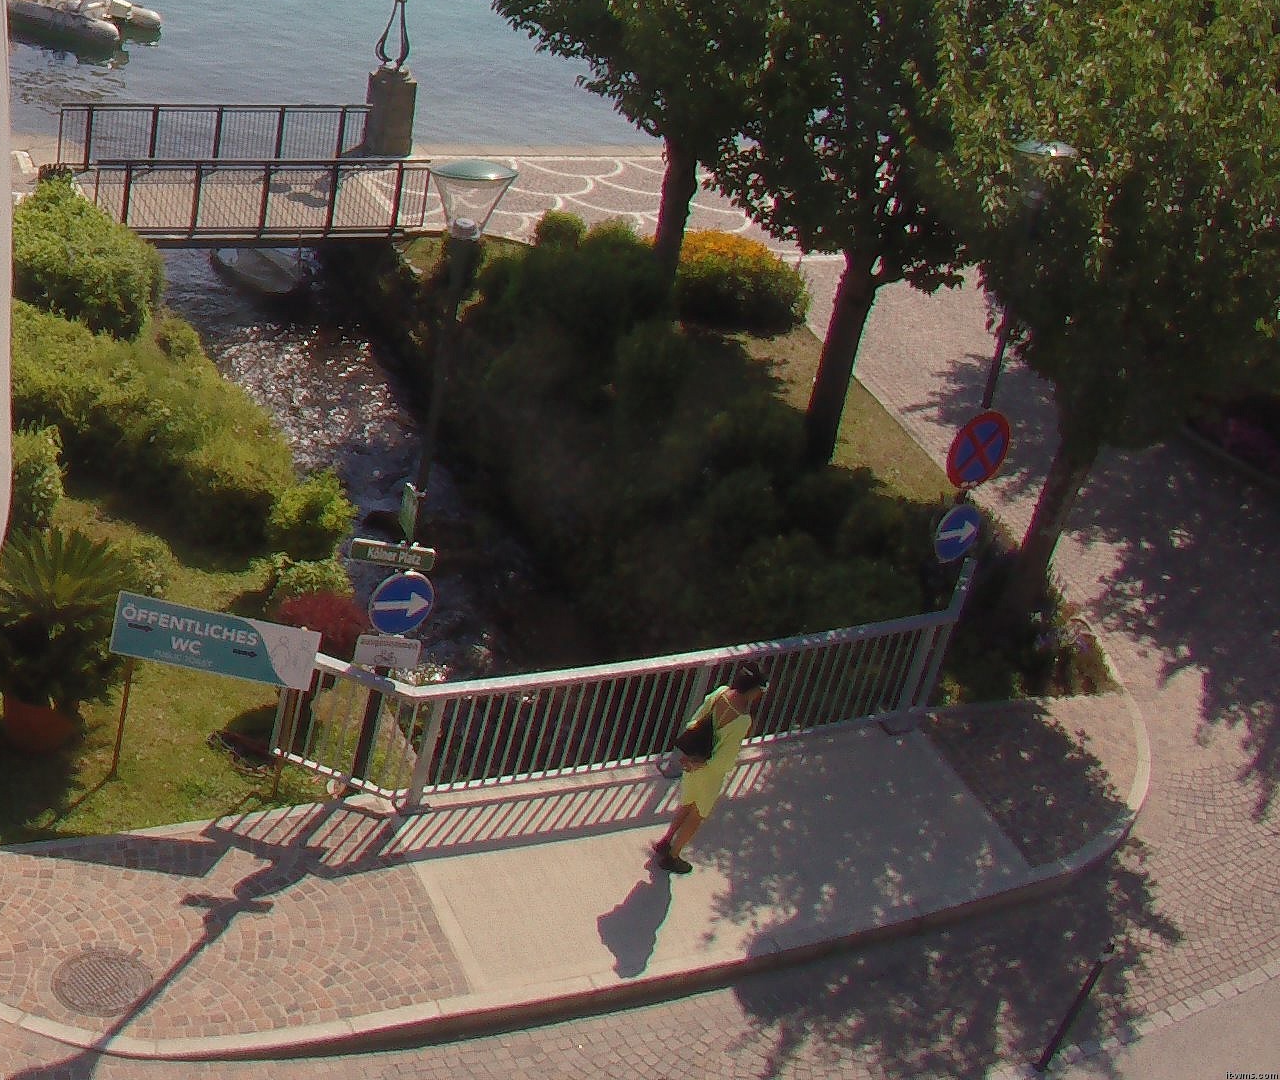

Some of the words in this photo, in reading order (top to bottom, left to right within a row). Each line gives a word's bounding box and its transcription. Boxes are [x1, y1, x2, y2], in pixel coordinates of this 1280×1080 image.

[399, 551, 421, 566] Platz
[121, 602, 259, 647] ÖFFENTLICHES
[170, 636, 202, 656] WC
